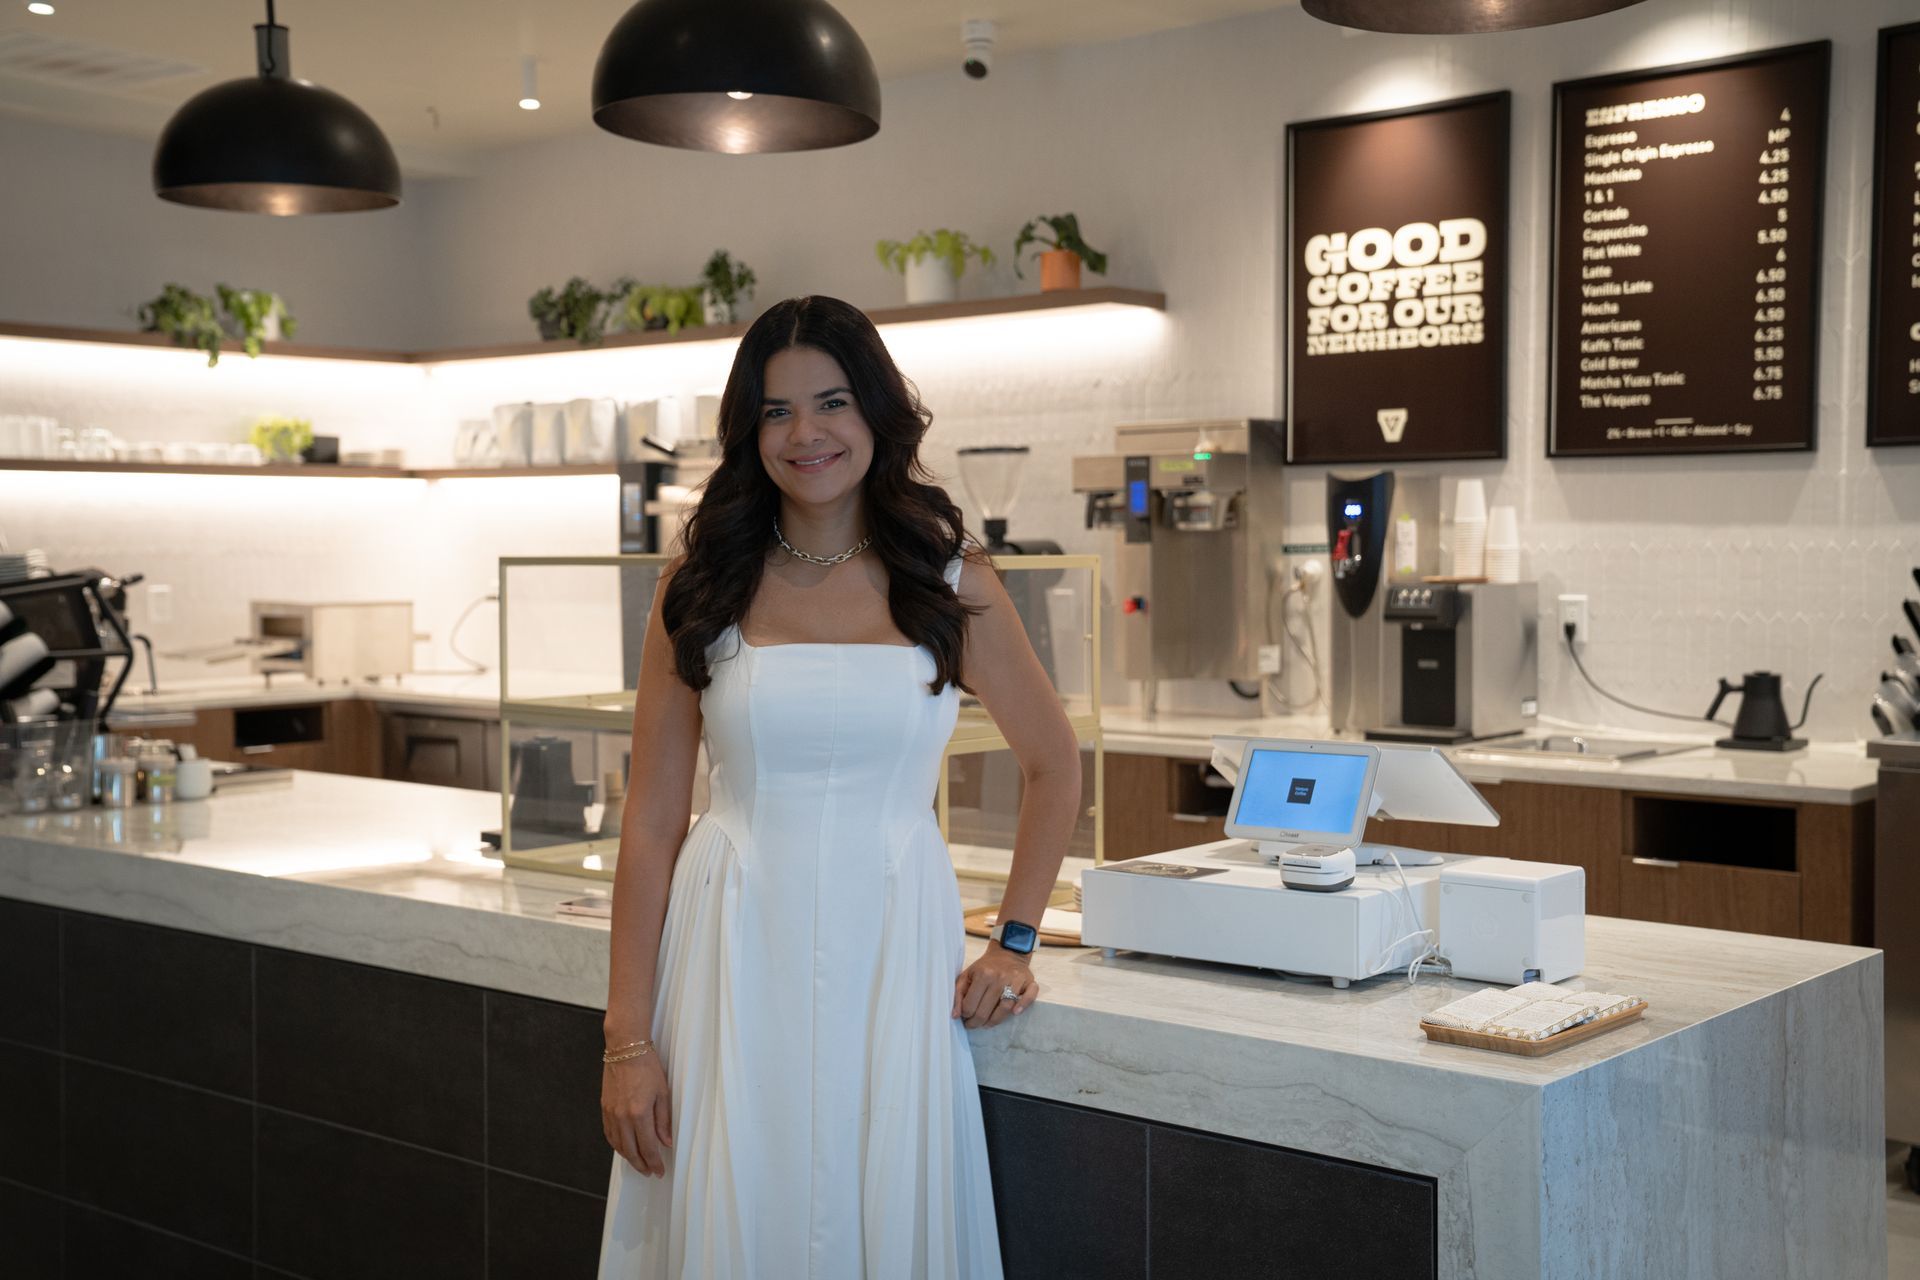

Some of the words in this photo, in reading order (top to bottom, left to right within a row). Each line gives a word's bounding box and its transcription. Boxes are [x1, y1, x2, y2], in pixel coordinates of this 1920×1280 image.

[1584, 131, 1637, 149] Espresso
[1584, 150, 1620, 168] Single
[1622, 145, 1658, 163] Origin
[1659, 140, 1714, 159] Espresso
[1768, 127, 1791, 144] MP
[1584, 168, 1642, 186] Macchiato
[1585, 190, 1592, 205] 1
[1607, 188, 1614, 202] 1
[1583, 206, 1629, 223] Cortado
[1583, 223, 1648, 243] Cappuccino
[1304, 217, 1487, 276] GOOD
[1583, 246, 1606, 261] Flat
[1606, 242, 1642, 259] White
[1582, 265, 1612, 280] Latte
[1307, 260, 1484, 306] COFFEE
[1582, 282, 1622, 298] Vanilla
[1623, 280, 1654, 295] Latte
[1307, 301, 1389, 335] FOR
[1393, 293, 1485, 327] OUR
[1581, 301, 1619, 317] Mocha
[1581, 318, 1642, 335] Americano
[1307, 322, 1485, 356] NEIGHBORS
[1612, 336, 1645, 352] Tonic
[1580, 356, 1607, 372] Cold
[1607, 355, 1640, 371] Brew
[1580, 374, 1622, 390] Matcha
[1622, 373, 1652, 388] Yuzu
[1652, 370, 1686, 386] Tonic
[1580, 394, 1602, 409] The
[1602, 393, 1651, 410] Vaquero
